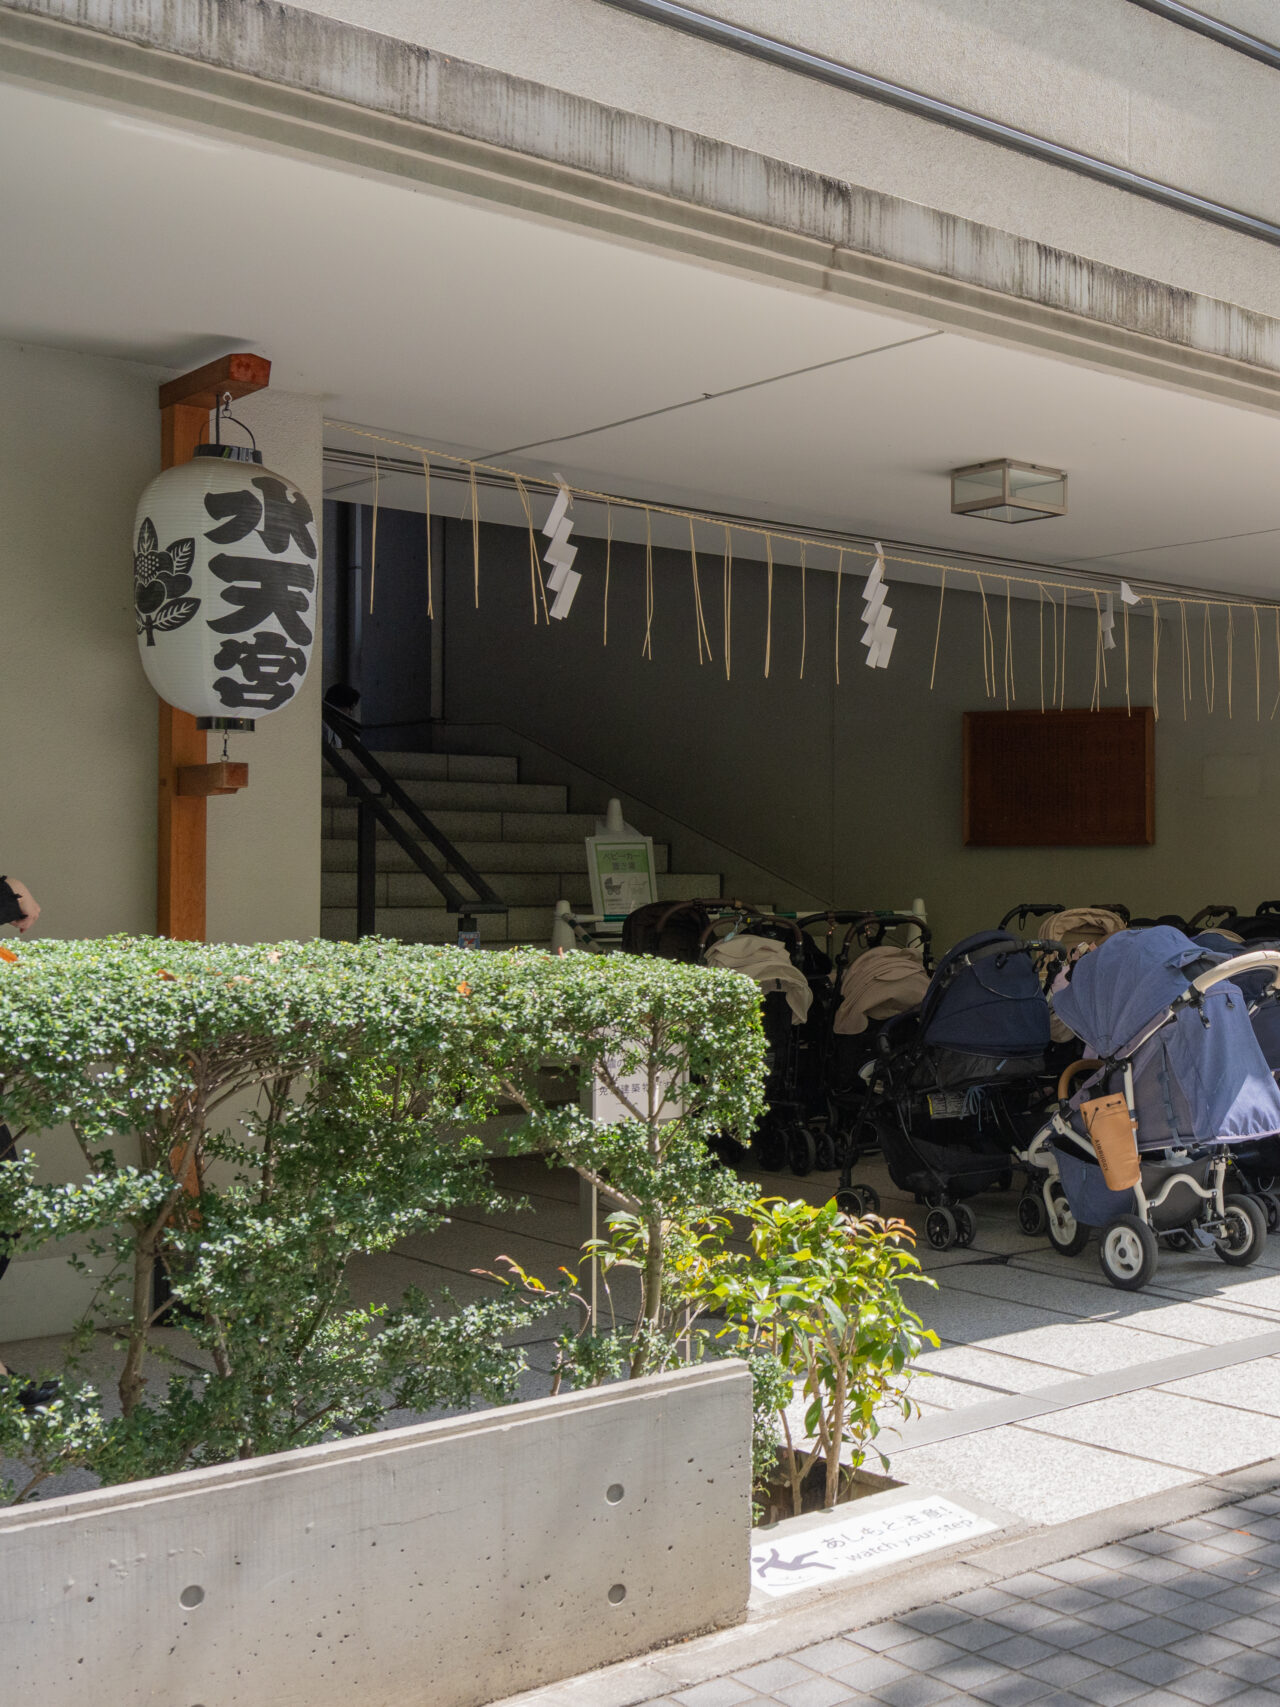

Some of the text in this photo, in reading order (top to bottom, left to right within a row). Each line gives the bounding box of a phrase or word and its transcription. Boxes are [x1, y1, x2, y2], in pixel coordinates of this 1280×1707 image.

[203, 476, 318, 710] 水天宮
[899, 1530, 936, 1547] your
[937, 1518, 974, 1533] step
